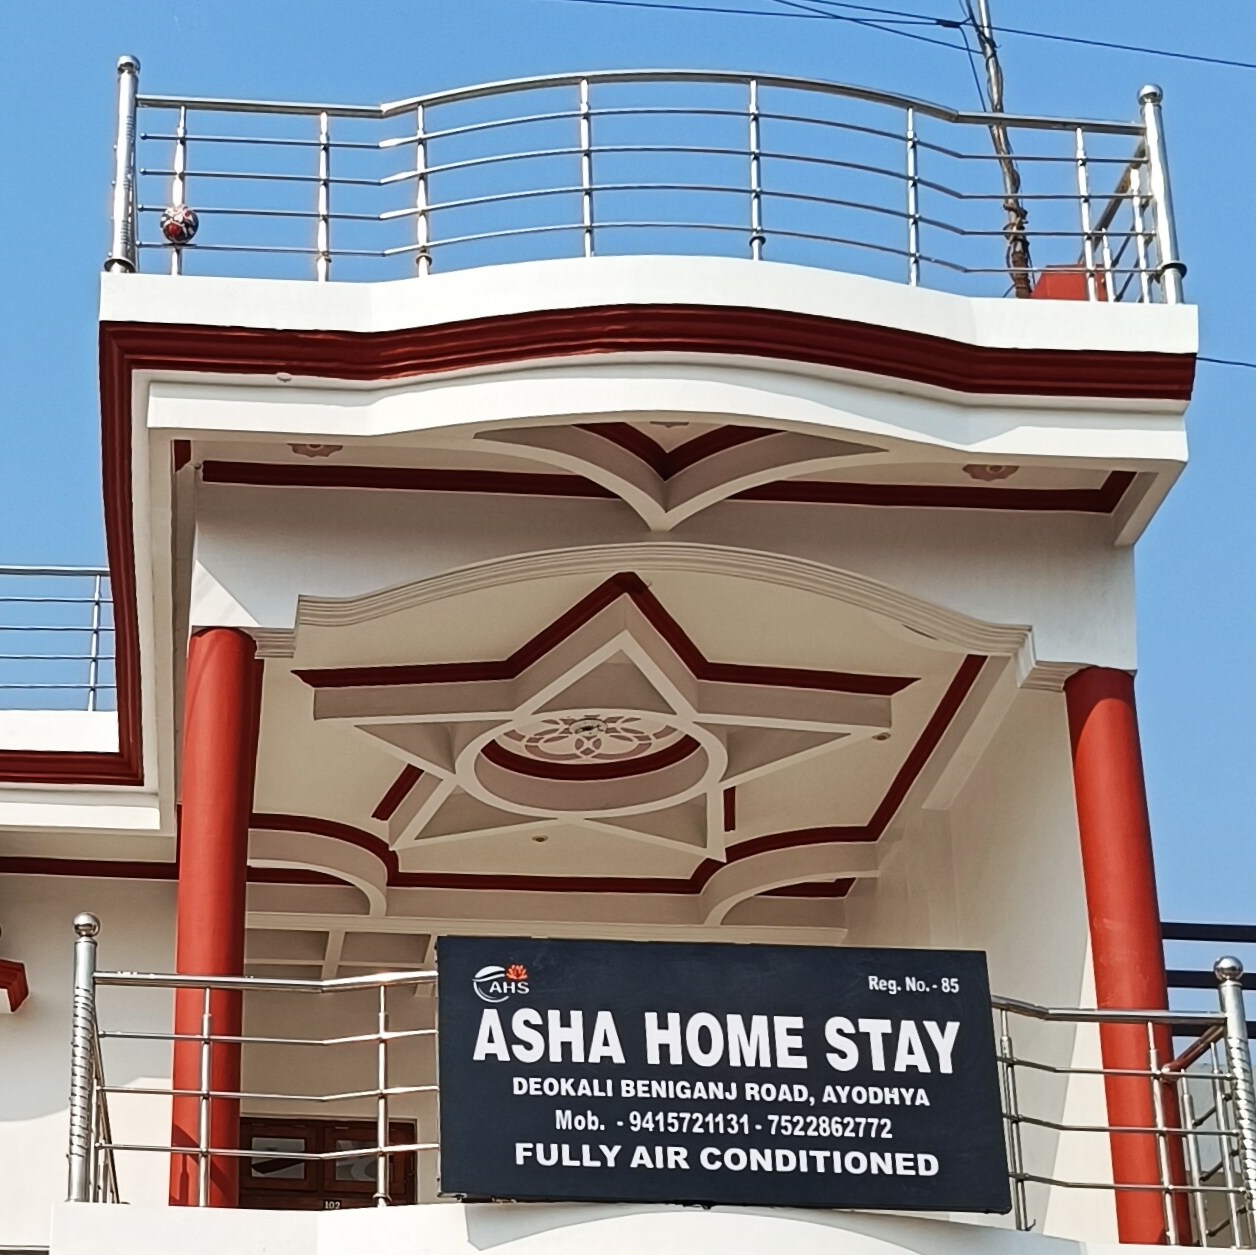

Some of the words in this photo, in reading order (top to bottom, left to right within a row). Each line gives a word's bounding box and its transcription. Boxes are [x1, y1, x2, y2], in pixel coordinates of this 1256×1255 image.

[489, 981, 530, 994] AHS
[868, 975, 902, 995] Reg.
[941, 978, 960, 993] 85
[473, 1007, 626, 1064] ASHA
[645, 1011, 808, 1069] HOME
[824, 1016, 961, 1074] STAY
[512, 1077, 614, 1097] DEOKALI
[620, 1079, 738, 1101] BENIGANJ
[744, 1083, 816, 1106] ROAD,
[822, 1085, 931, 1106] AYODHYA
[555, 1109, 606, 1131] Mob.
[629, 1111, 750, 1134] 9415721131
[767, 1115, 893, 1139] 7522862772
[515, 1143, 622, 1167] FULLY
[630, 1146, 691, 1169] AIR
[699, 1147, 940, 1176] CONDITIONED
[324, 1200, 341, 1210] 102
